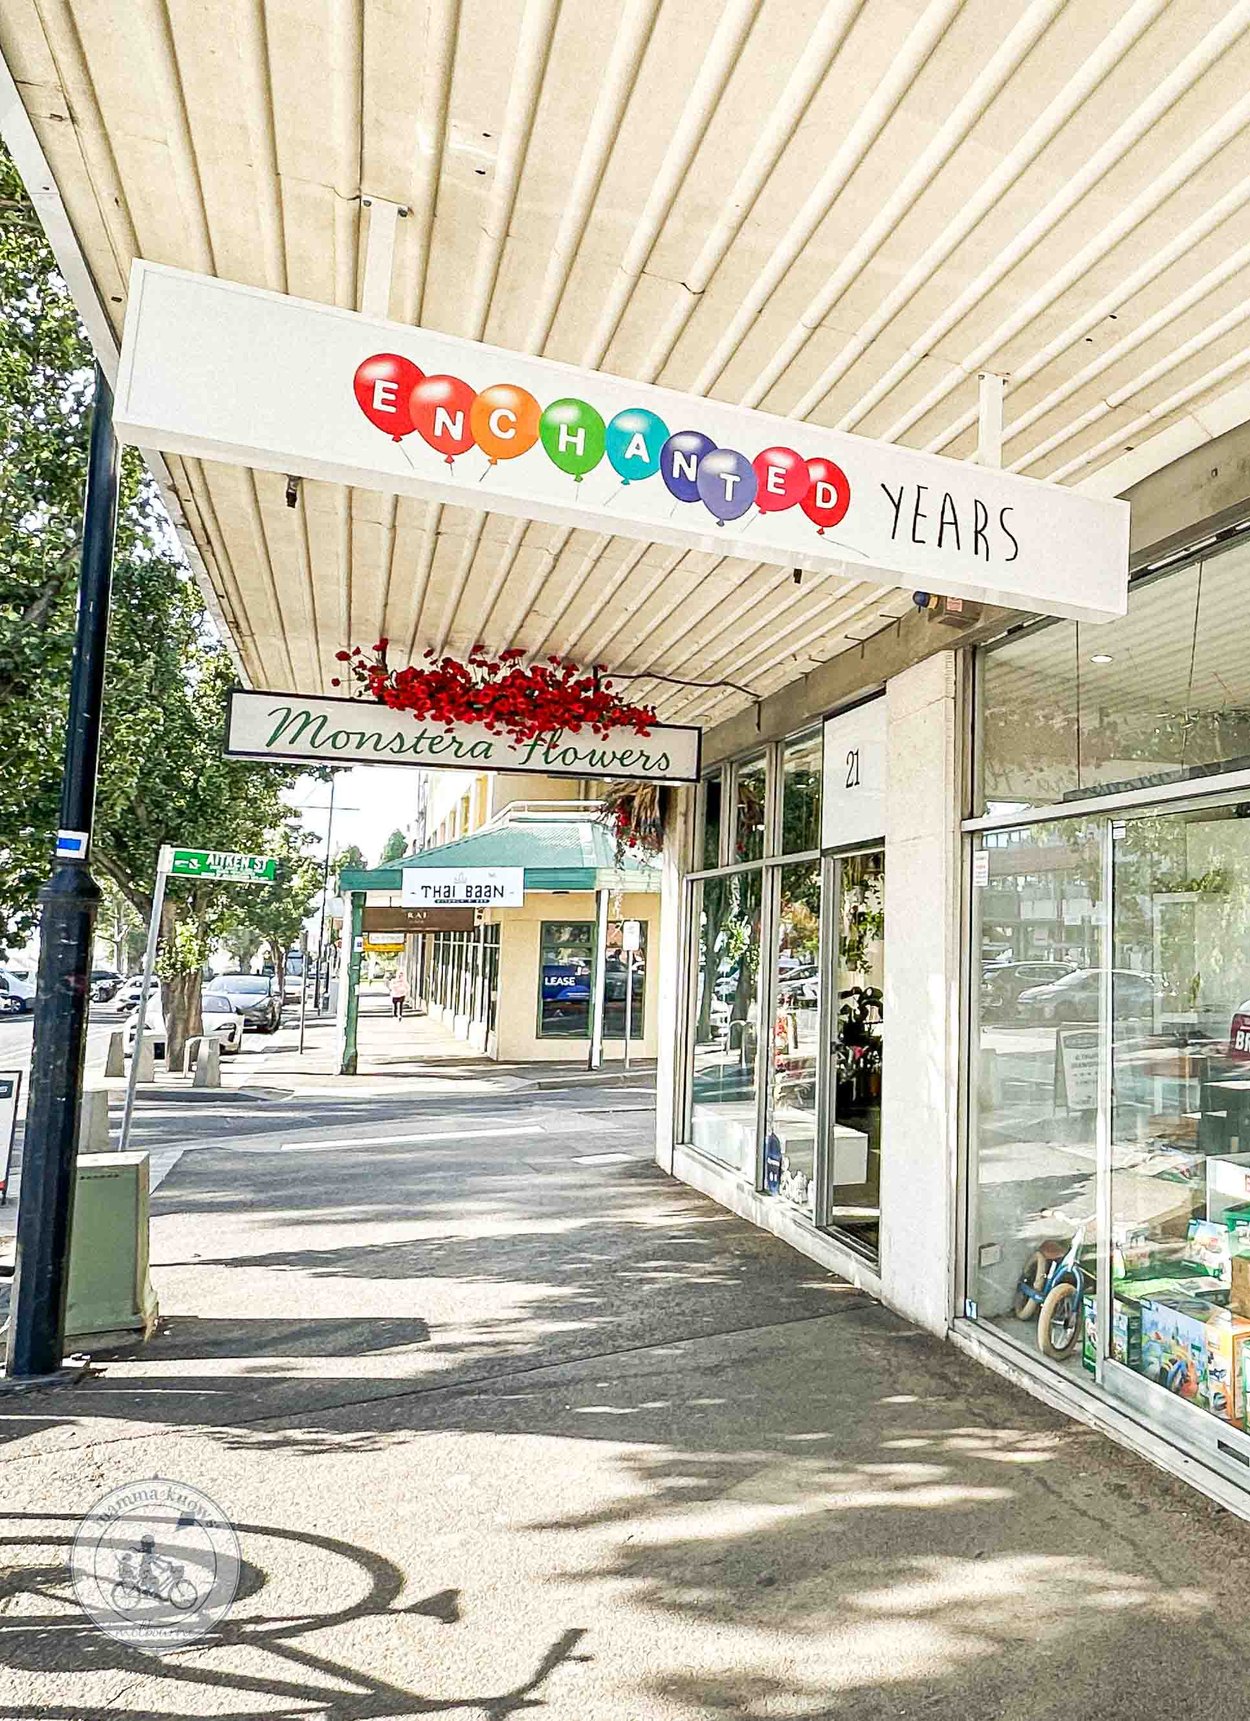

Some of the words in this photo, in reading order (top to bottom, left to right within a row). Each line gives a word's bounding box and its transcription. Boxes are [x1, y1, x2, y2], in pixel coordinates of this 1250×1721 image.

[372, 377, 838, 511] ENCHANTED
[879, 481, 1020, 563] YEARS
[266, 706, 493, 760] Monstera
[845, 747, 861, 789] 21
[206, 853, 249, 868] AITKEN
[254, 859, 268, 872] ST
[544, 976, 576, 986] LEASE
